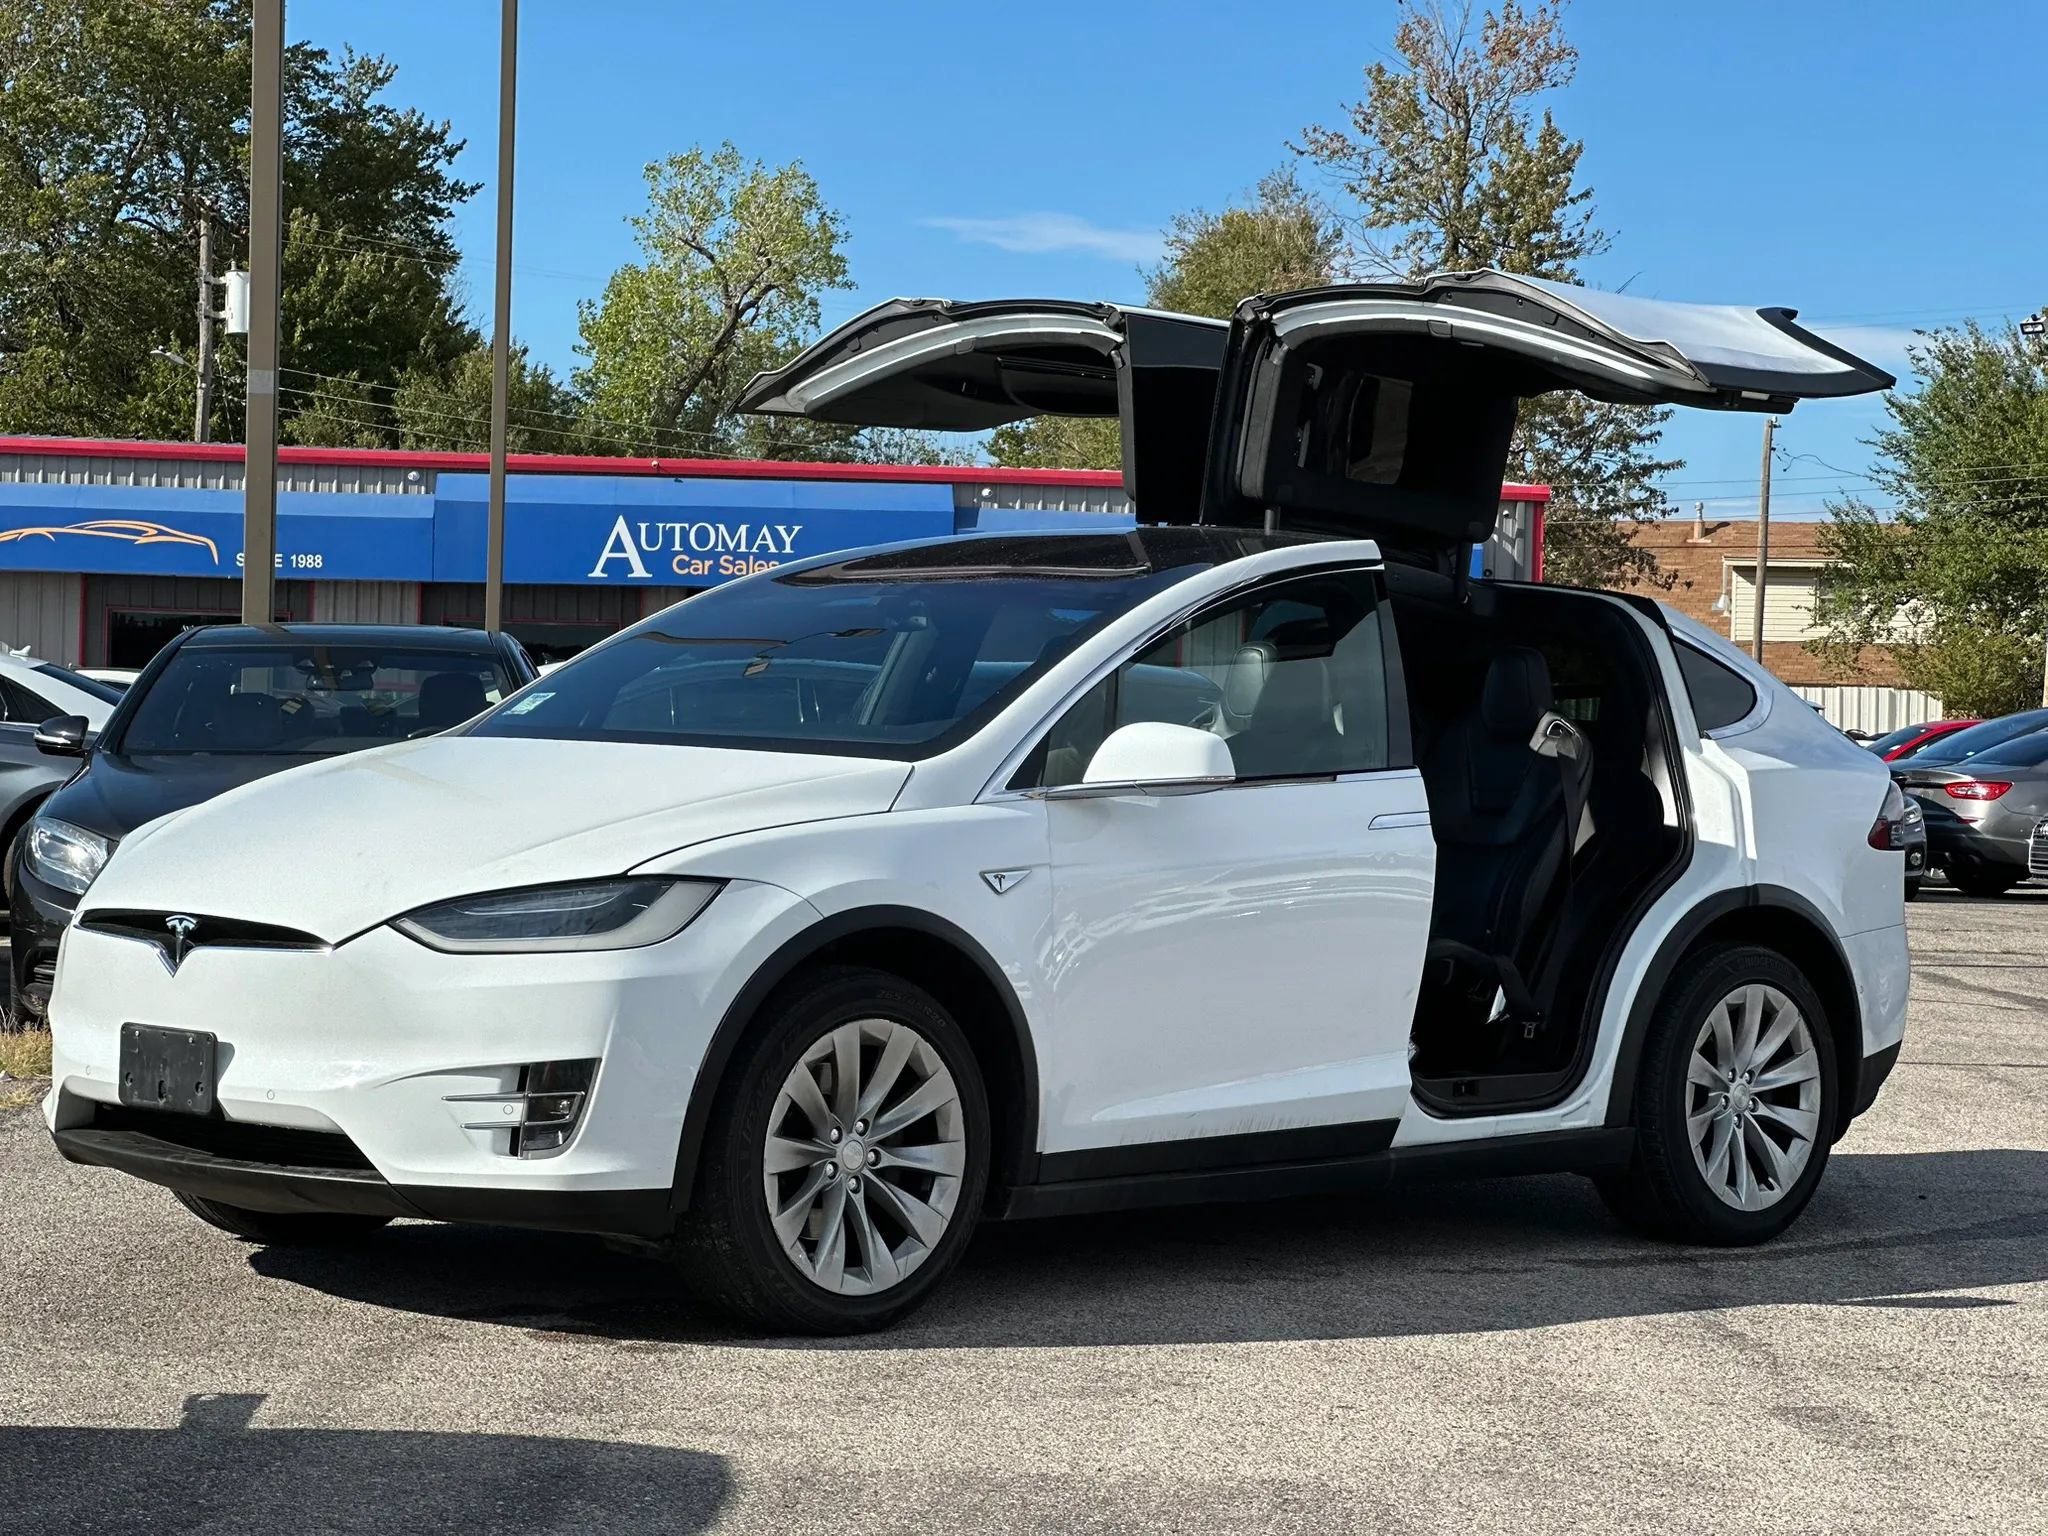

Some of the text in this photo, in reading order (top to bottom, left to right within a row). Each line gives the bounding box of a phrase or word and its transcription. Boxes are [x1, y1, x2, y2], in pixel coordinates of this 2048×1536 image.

[588, 515, 803, 578] AUTOMAY
[290, 553, 323, 569] 1988
[672, 555, 713, 576] Car
